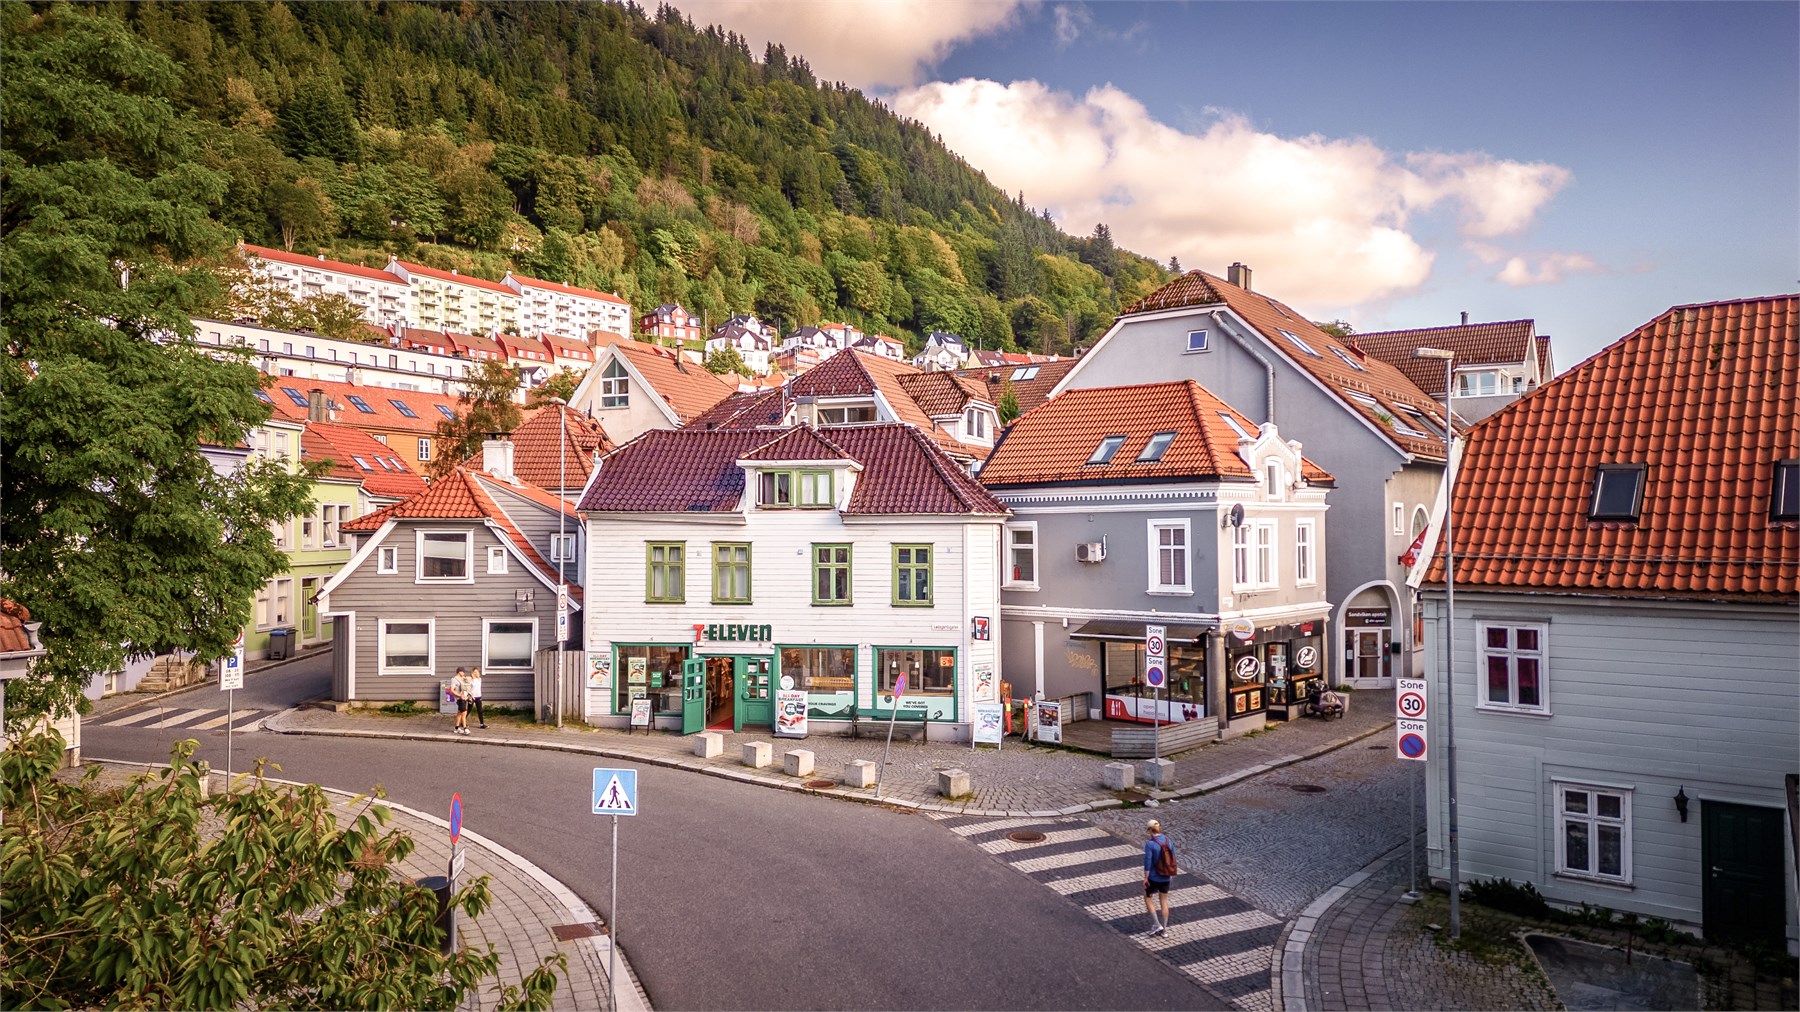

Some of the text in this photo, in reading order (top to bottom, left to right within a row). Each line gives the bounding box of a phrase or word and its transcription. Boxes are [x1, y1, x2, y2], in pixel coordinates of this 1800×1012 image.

[1151, 641, 1160, 650] 30
[1400, 681, 1424, 690] Sone
[1404, 699, 1420, 711] 30
[1400, 721, 1424, 731] Sone
